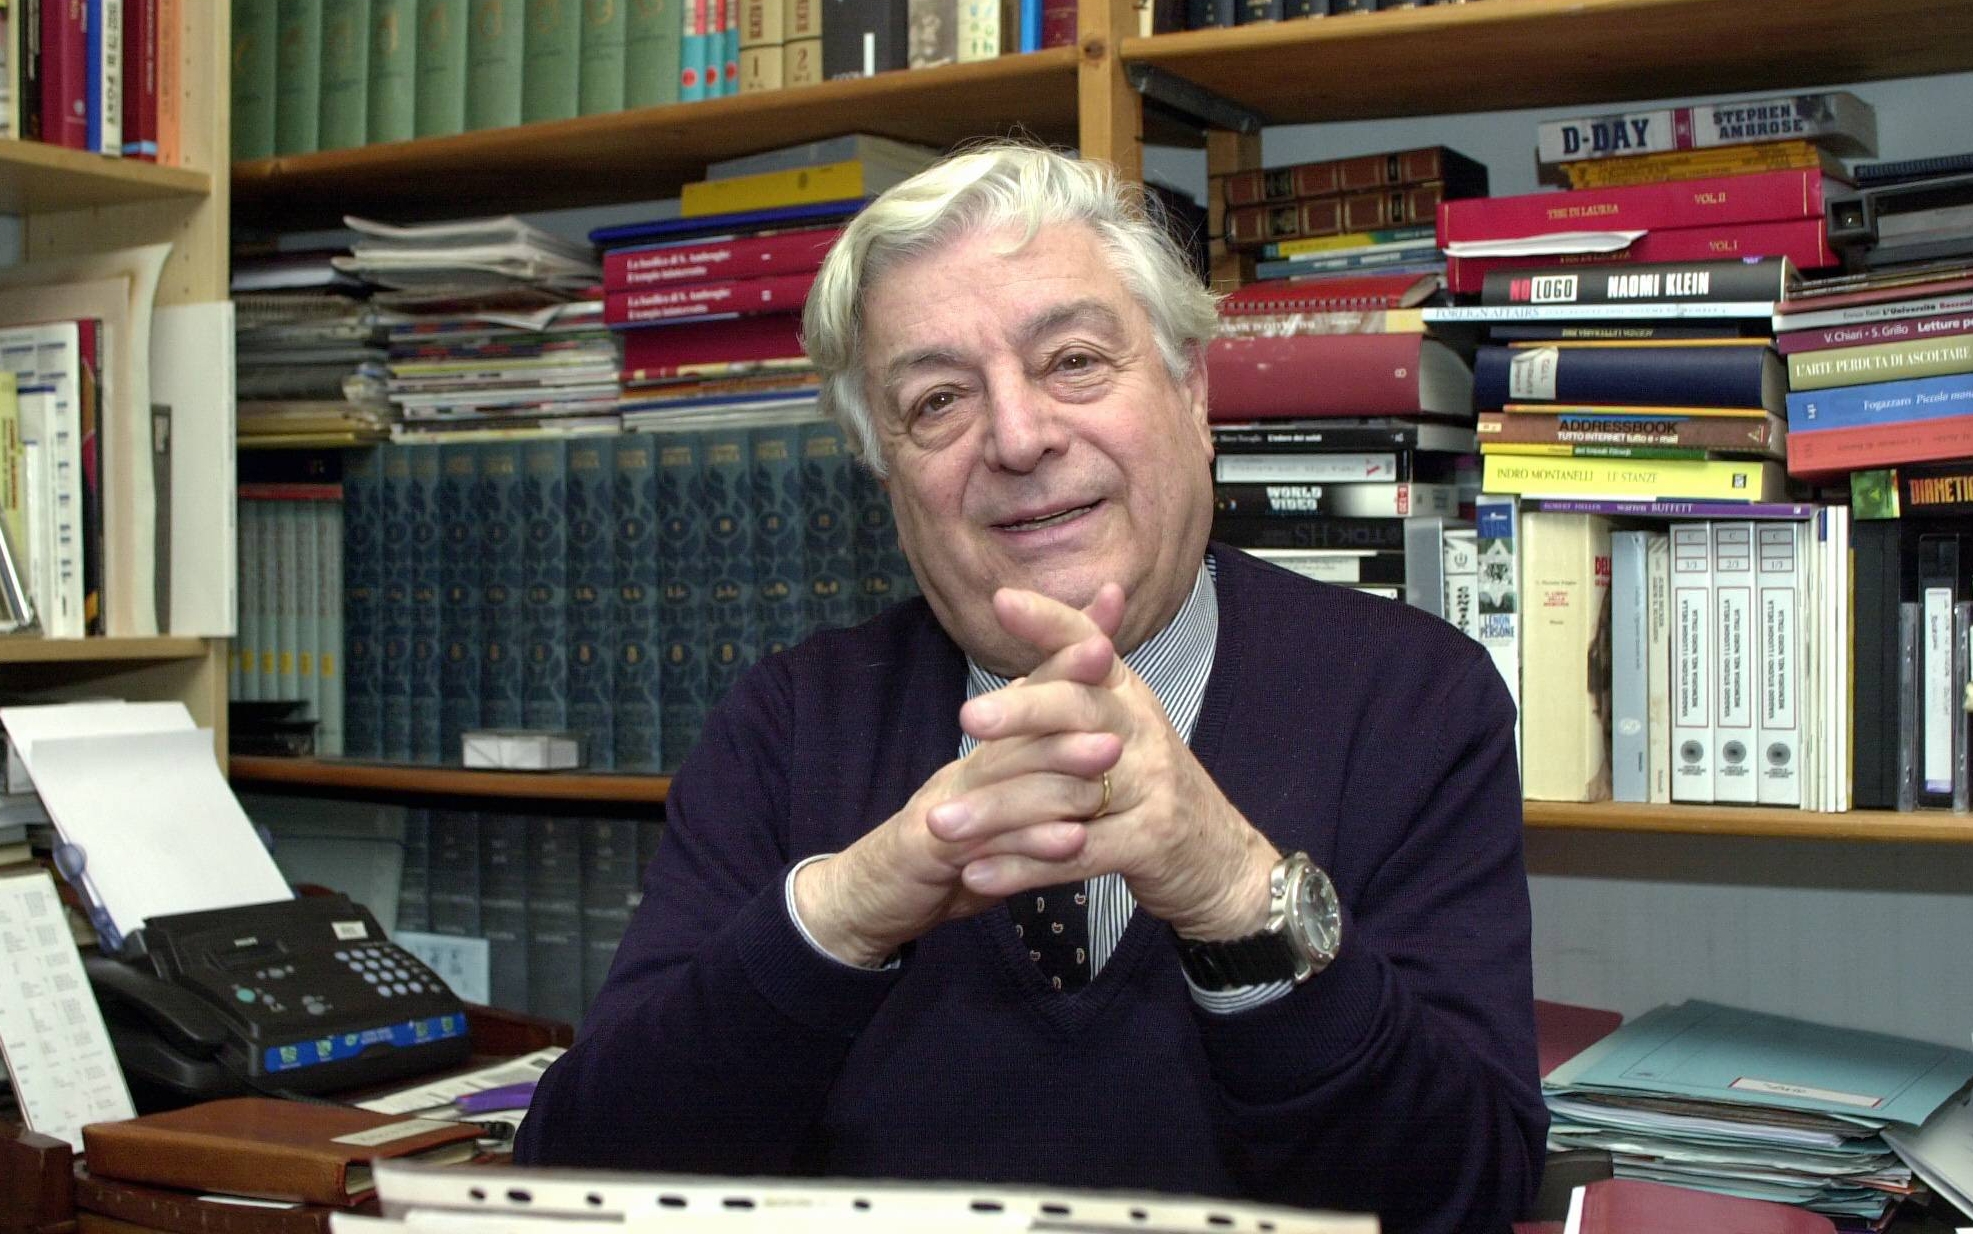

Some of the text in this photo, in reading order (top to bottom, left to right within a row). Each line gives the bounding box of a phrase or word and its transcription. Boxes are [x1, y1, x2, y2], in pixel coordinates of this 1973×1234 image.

[1713, 104, 1792, 125] STEPHEN
[1562, 118, 1649, 155] D-DAY
[1719, 118, 1804, 140] AMBROSE
[1510, 272, 1710, 300] NO LOGO NAOMI KLEIN
[1436, 307, 1539, 320] FOREIGN AFFAIRS
[1834, 329, 1863, 342] Chiari
[1871, 327, 1881, 338] S.
[1882, 324, 1909, 337] Grillo
[1917, 318, 1960, 333] Letture
[1796, 346, 1971, 378] L'ARTE PERDUTA DI ASCOLTARE
[1863, 397, 1912, 412] Fogazzaro
[1916, 390, 1949, 406] Piccolo
[1559, 420, 1678, 434] ADDRESSBOOK
[1557, 432, 1584, 442] TUTTO
[1585, 432, 1626, 443] INTERNET
[1497, 468, 1658, 483] INDRO MONTANELLI LE STANZE
[1266, 486, 1322, 499] WORLD
[1270, 499, 1318, 511] VIDEO
[1616, 503, 1647, 512] Warren
[1652, 502, 1693, 513] BUFFETT
[1480, 625, 1515, 638] PERSONE
